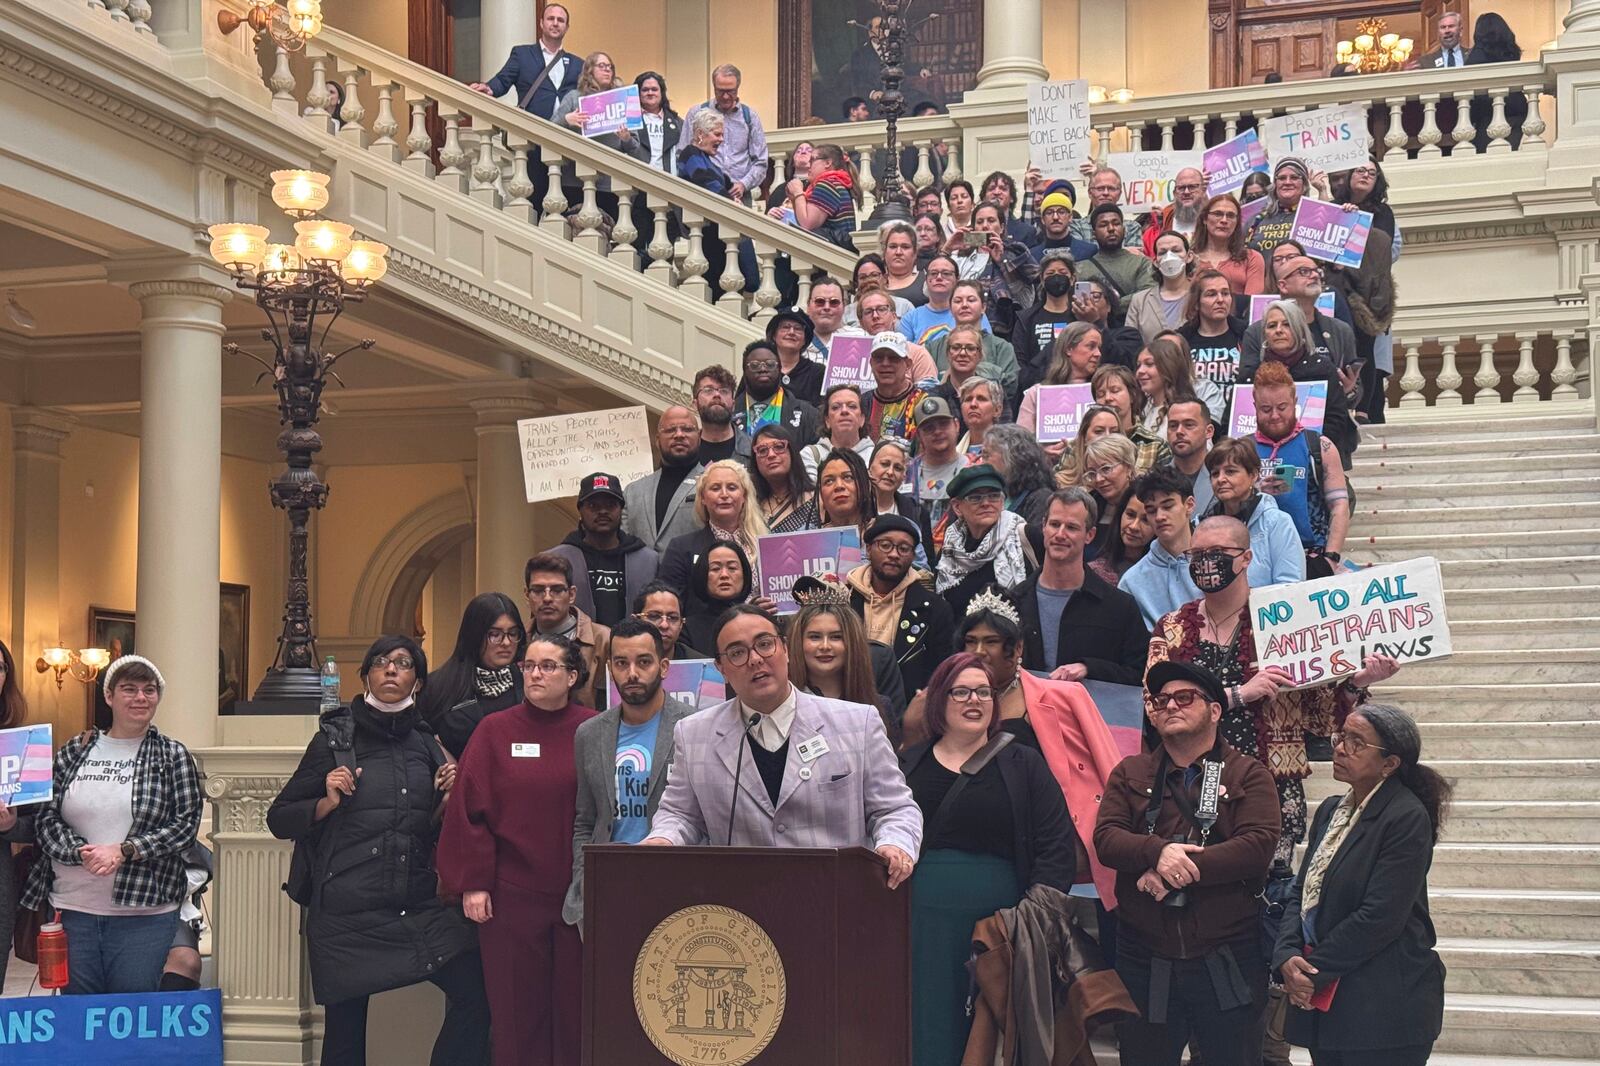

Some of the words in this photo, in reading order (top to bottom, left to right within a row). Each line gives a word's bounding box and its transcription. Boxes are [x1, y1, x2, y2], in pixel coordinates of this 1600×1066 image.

[1029, 104, 1058, 126] MAKE
[1069, 102, 1087, 120] ME
[1285, 111, 1345, 132] PROTECT
[1030, 129, 1058, 146] COME
[1063, 126, 1091, 141] BACK
[1280, 123, 1351, 152] TRANS
[1046, 142, 1077, 163] HERE
[1133, 153, 1169, 171] Georgia
[1297, 225, 1324, 240] SHOW
[1295, 236, 1313, 249] TRANS
[1313, 240, 1345, 256] GEORGIANS
[831, 366, 859, 379] SHOW
[860, 357, 873, 380] U
[524, 421, 560, 437] TRANS
[566, 416, 599, 431] PEOPLE
[1043, 425, 1066, 433] TRANS
[1044, 413, 1074, 425] SHOW
[527, 438, 546, 449] ALL
[546, 436, 558, 447] OF
[564, 433, 577, 444] THE
[593, 440, 610, 451] AND
[540, 480, 553, 493] AM
[558, 478, 564, 490] A
[1194, 560, 1219, 574] SHE
[769, 573, 803, 591] SHOW
[1195, 574, 1221, 588] HER
[1257, 600, 1294, 631] NO
[1308, 588, 1350, 619] TO
[1361, 574, 1418, 606] ALL
[1263, 602, 1434, 660] ANTI-TRANS
[1329, 649, 1357, 676] &
[115, 759, 136, 769] righ
[113, 773, 135, 785] righ
[625, 777, 649, 797] Kid
[684, 935, 738, 957] CONSTITUTION
[646, 933, 678, 1001] STATE
[686, 914, 709, 928] OF
[728, 919, 777, 1006] GEORGIA
[85, 1003, 213, 1042] FOLKS
[691, 1046, 727, 1060] 1776
